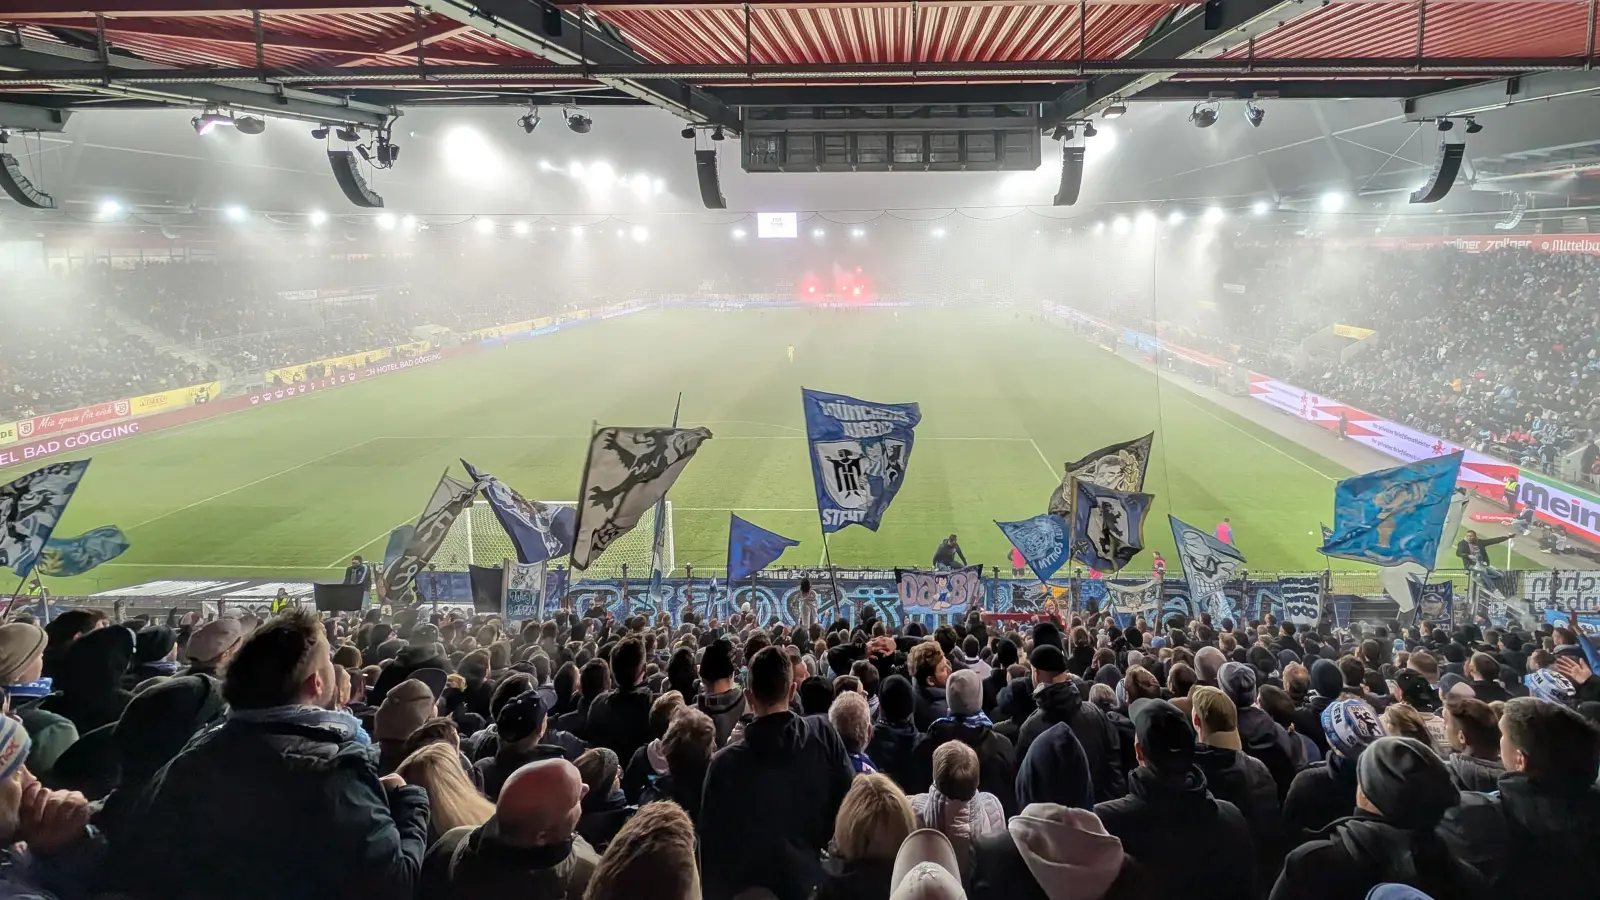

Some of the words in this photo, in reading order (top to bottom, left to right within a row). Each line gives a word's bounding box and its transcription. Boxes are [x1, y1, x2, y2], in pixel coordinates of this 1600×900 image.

[377, 364, 399, 375] HOTEL
[400, 358, 414, 368] BAD
[24, 441, 60, 459] BAD
[1521, 482, 1600, 534] mein
[1038, 542, 1064, 570] MYTHOS
